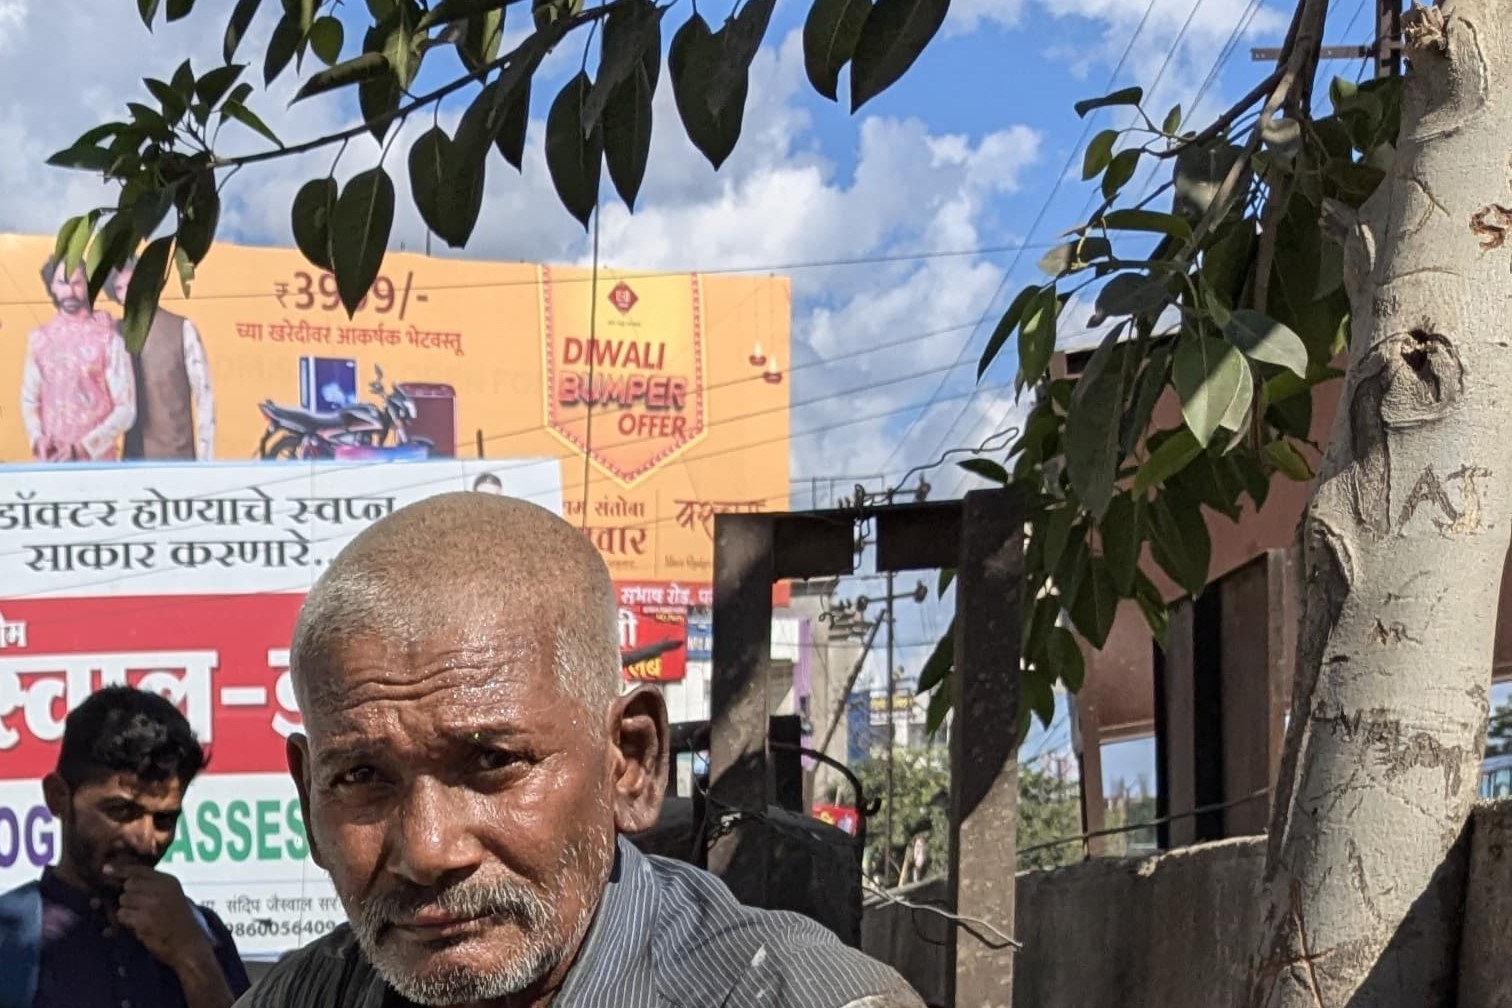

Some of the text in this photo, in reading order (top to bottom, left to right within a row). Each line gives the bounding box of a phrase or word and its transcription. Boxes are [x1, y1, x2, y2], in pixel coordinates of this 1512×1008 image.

[275, 271, 430, 320] ₹399/-
[268, 319, 331, 344] खरेदीवर
[337, 322, 401, 346] आकर्षक
[405, 324, 465, 356] भेटवस्तू
[562, 337, 666, 370] DIWALI
[558, 370, 689, 411] BUMPER
[617, 412, 687, 439] OFFER
[130, 487, 274, 529] होण्याचे
[286, 496, 396, 527] स्वप्न
[595, 497, 645, 517] संतोबा
[22, 541, 156, 572] साकार
[163, 799, 310, 863] ASSES
